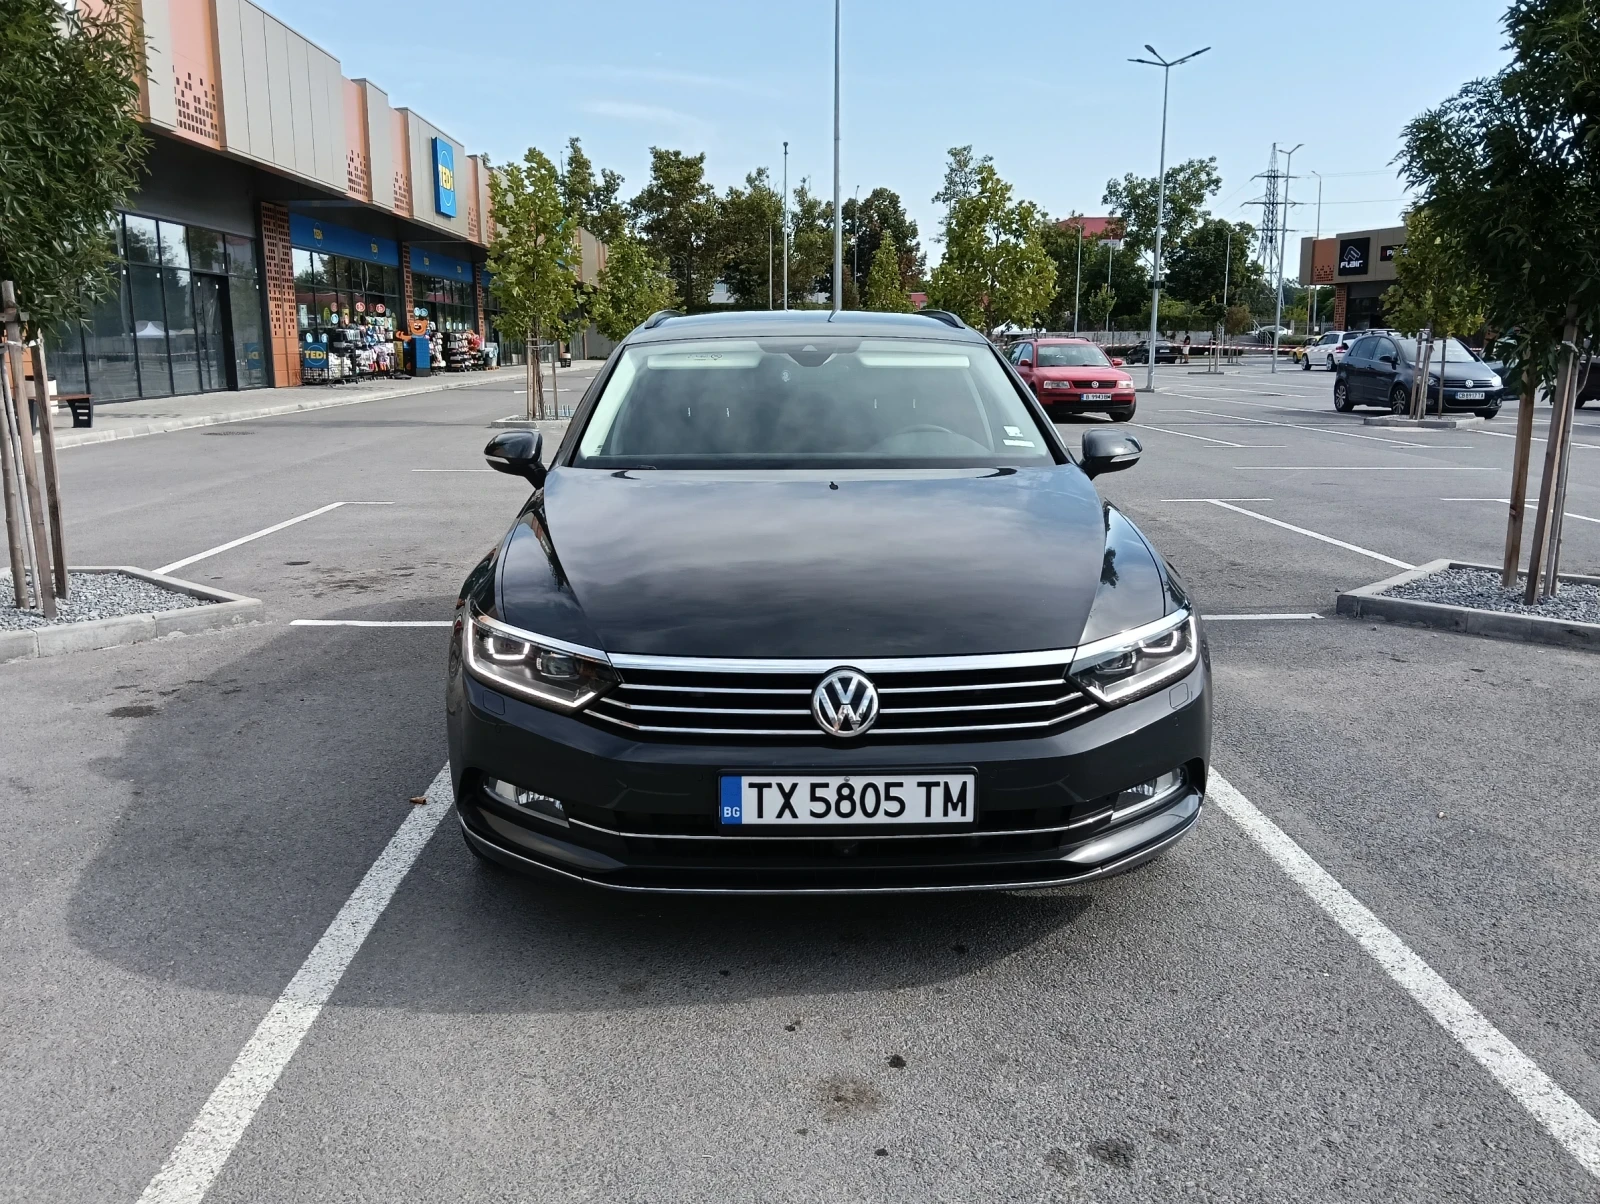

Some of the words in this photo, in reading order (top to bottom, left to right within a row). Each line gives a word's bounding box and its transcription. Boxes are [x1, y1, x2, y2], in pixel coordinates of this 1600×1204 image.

[304, 350, 326, 360] TEDi
[724, 806, 740, 818] BG
[748, 782, 799, 818] TX
[809, 782, 906, 818] 5805
[917, 781, 968, 818] TM
